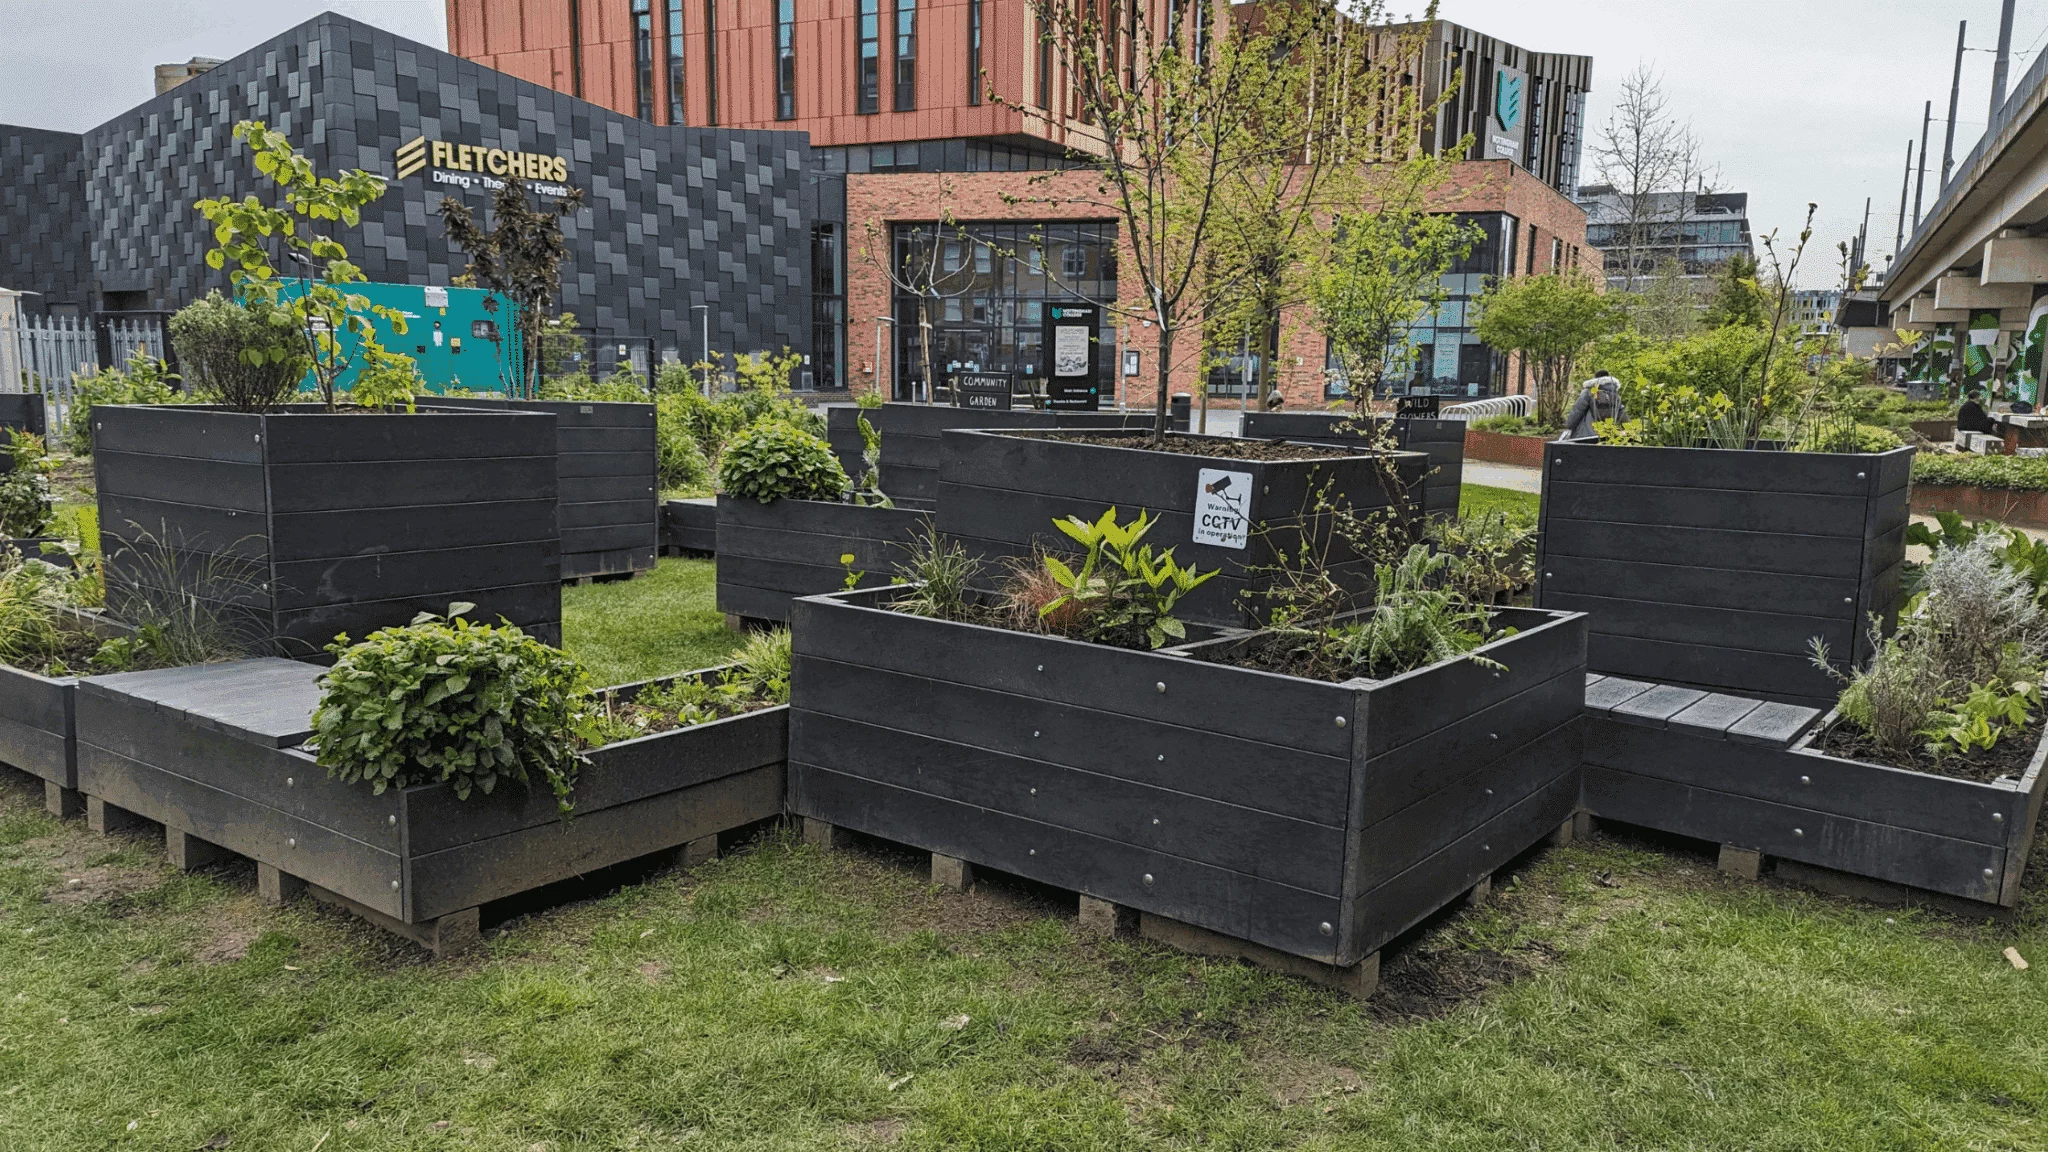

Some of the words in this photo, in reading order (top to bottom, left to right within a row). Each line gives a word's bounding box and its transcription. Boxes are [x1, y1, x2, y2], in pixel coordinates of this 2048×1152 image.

[432, 140, 568, 183] FLETCHERS
[433, 171, 470, 188] Dining
[535, 183, 568, 197] Events
[963, 376, 1007, 388] COMMUNITY
[969, 396, 997, 407] GARDEN
[1404, 398, 1430, 408] WILD
[1208, 503, 1239, 514] Warning
[1202, 514, 1241, 531] CCTV
[1206, 531, 1246, 539] operation
